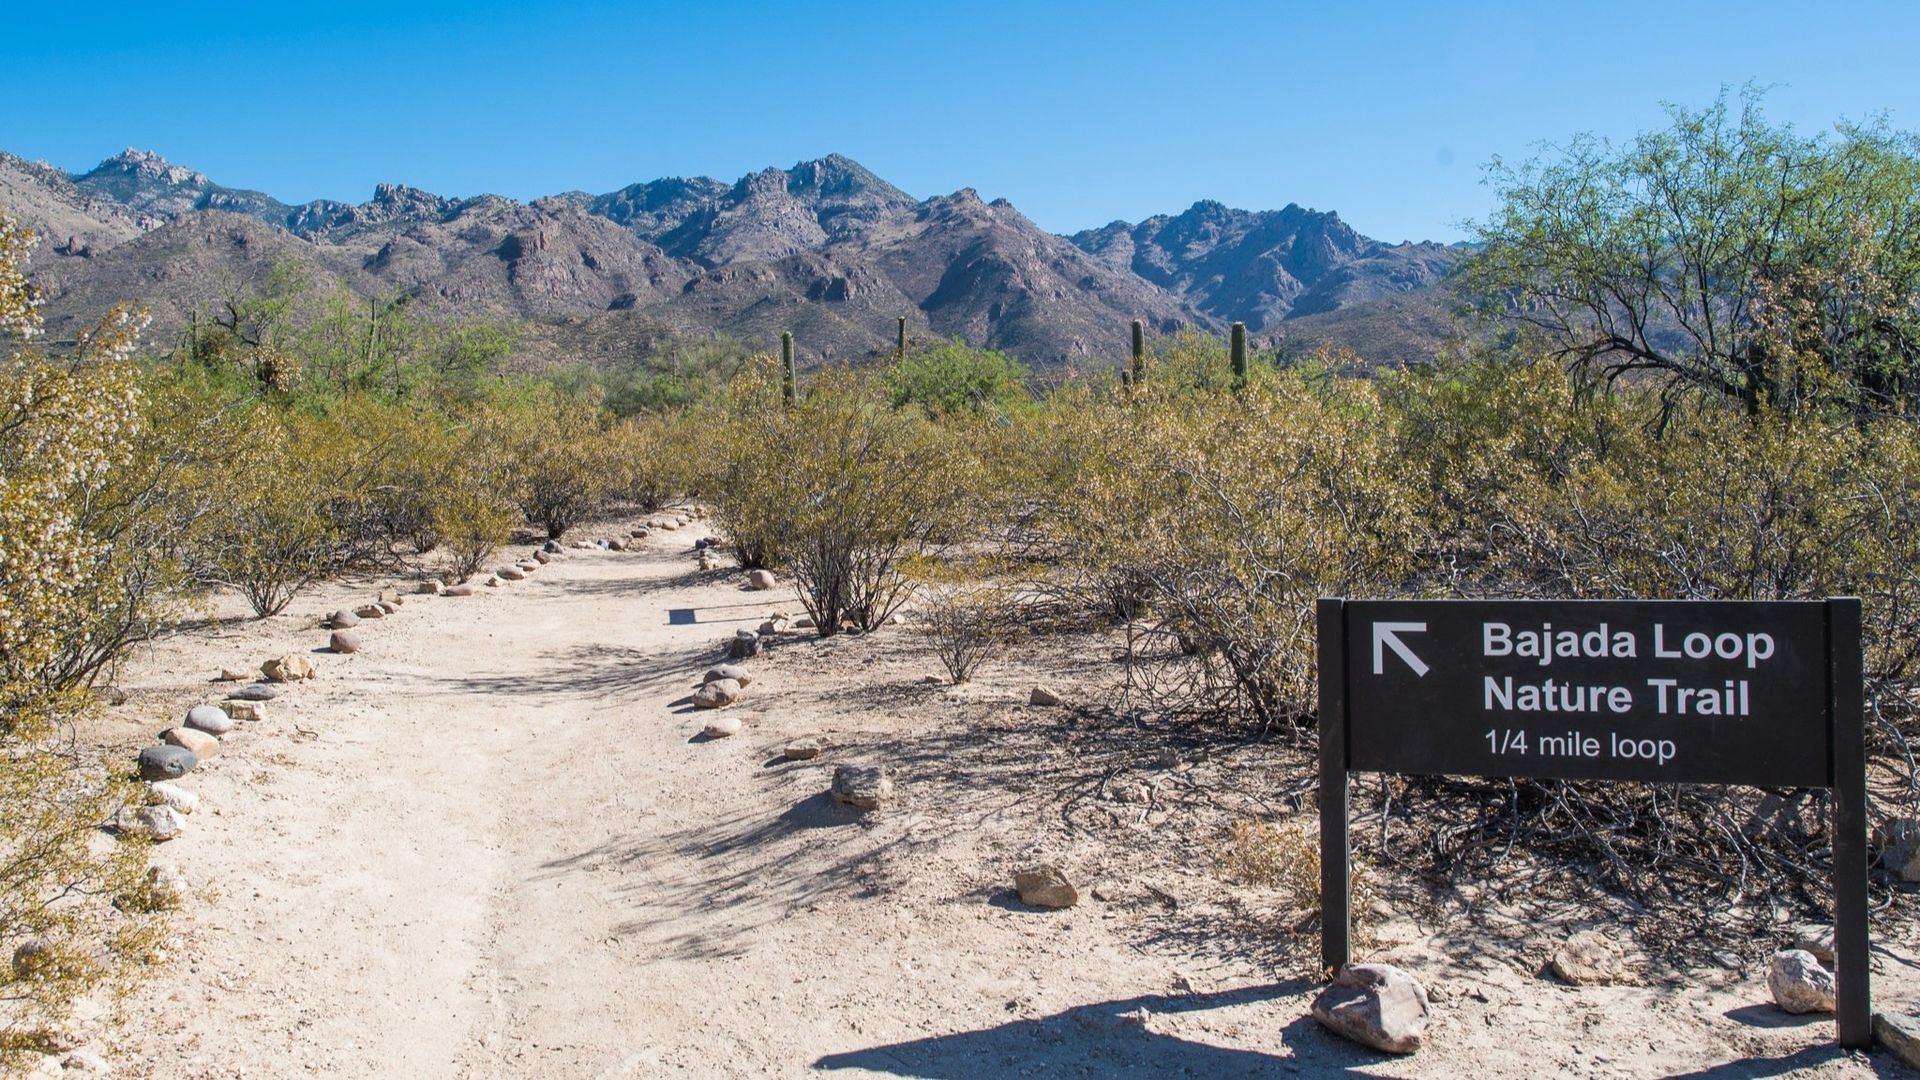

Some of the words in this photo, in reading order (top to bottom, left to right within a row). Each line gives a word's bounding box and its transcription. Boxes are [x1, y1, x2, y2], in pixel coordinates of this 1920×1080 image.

[1483, 622, 1637, 666] Bajada
[1654, 623, 1775, 668] Loop
[1484, 676, 1633, 713] Nature
[1647, 678, 1749, 716] Trail
[1485, 729, 1528, 755] 1/4
[1539, 731, 1600, 757] mile
[1611, 732, 1676, 766] loop
